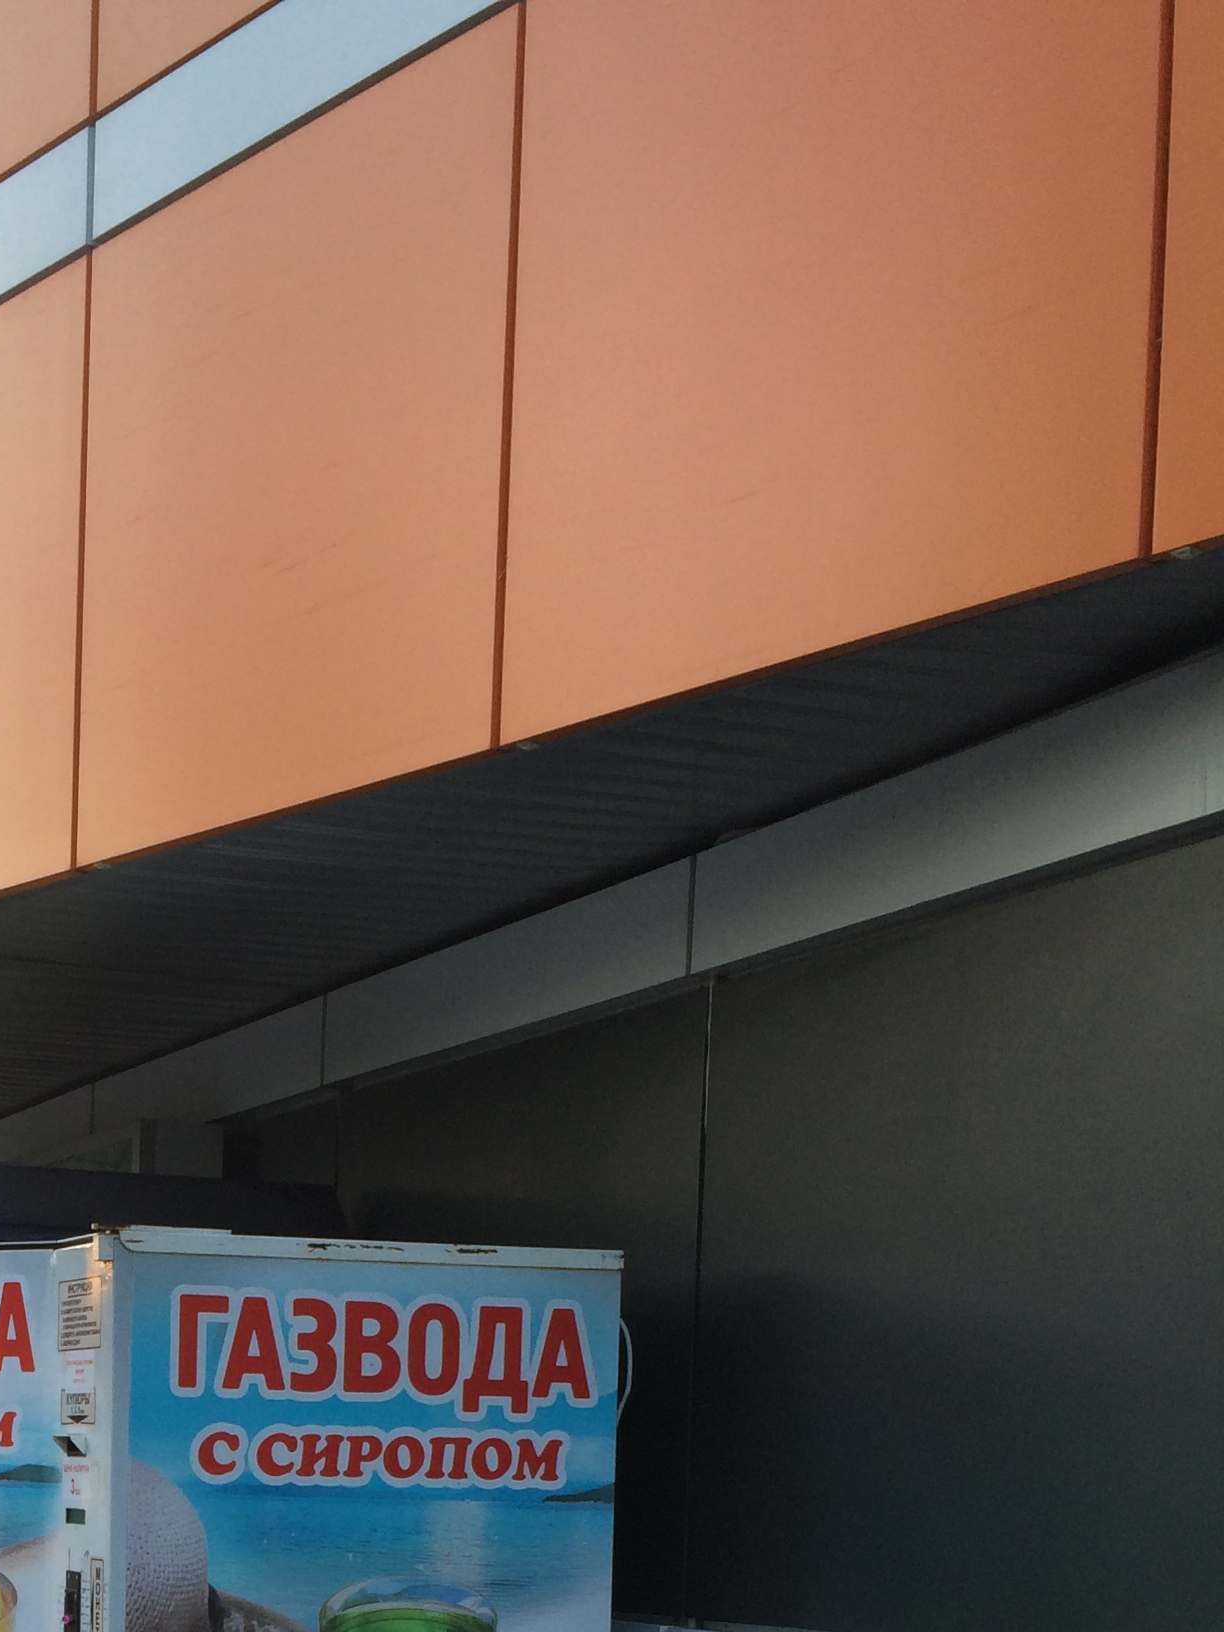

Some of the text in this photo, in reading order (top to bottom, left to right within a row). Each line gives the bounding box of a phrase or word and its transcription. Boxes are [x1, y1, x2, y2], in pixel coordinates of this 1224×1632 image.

[178, 1294, 591, 1414] ГАЗВОДА
[197, 1431, 564, 1482] С СИРОПОМ
